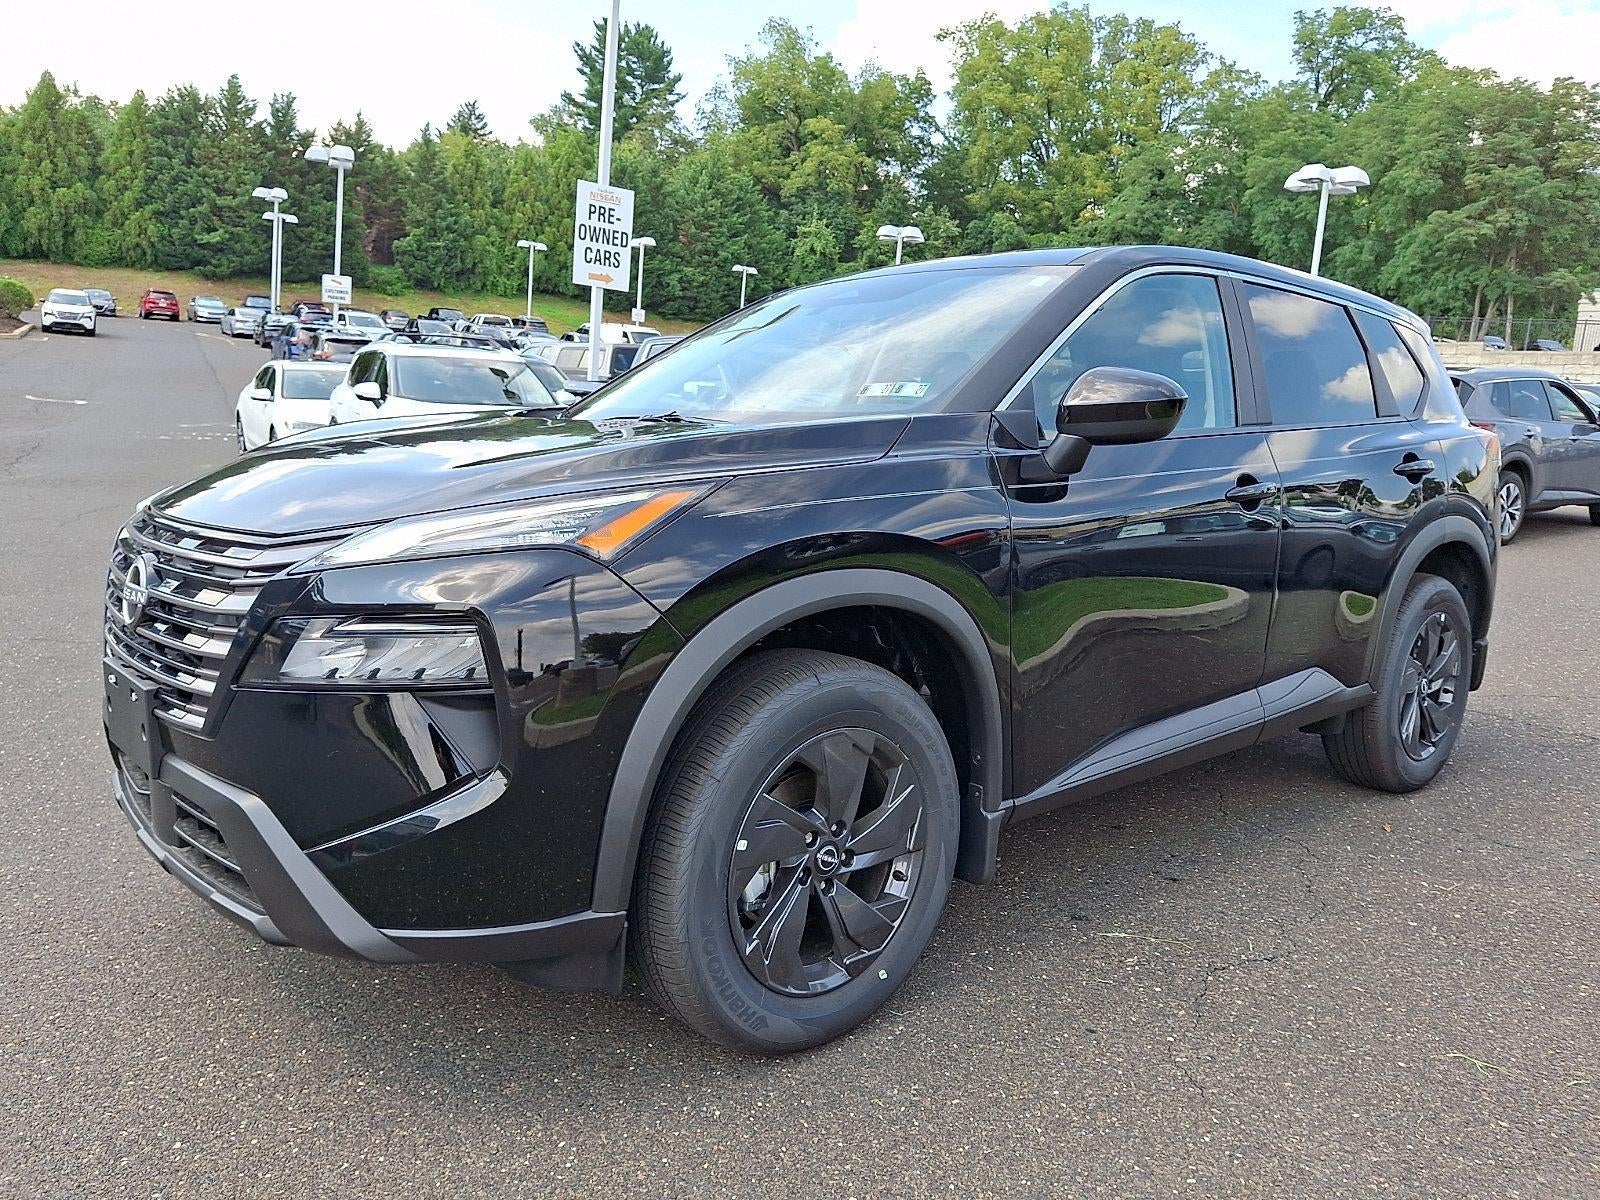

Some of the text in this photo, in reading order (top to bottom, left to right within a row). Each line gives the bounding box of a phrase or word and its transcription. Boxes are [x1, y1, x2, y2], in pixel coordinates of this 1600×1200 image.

[590, 191, 622, 203] NISSAN
[588, 203, 622, 225] PRE-
[578, 223, 629, 248] OWNED
[584, 246, 621, 269] CARS
